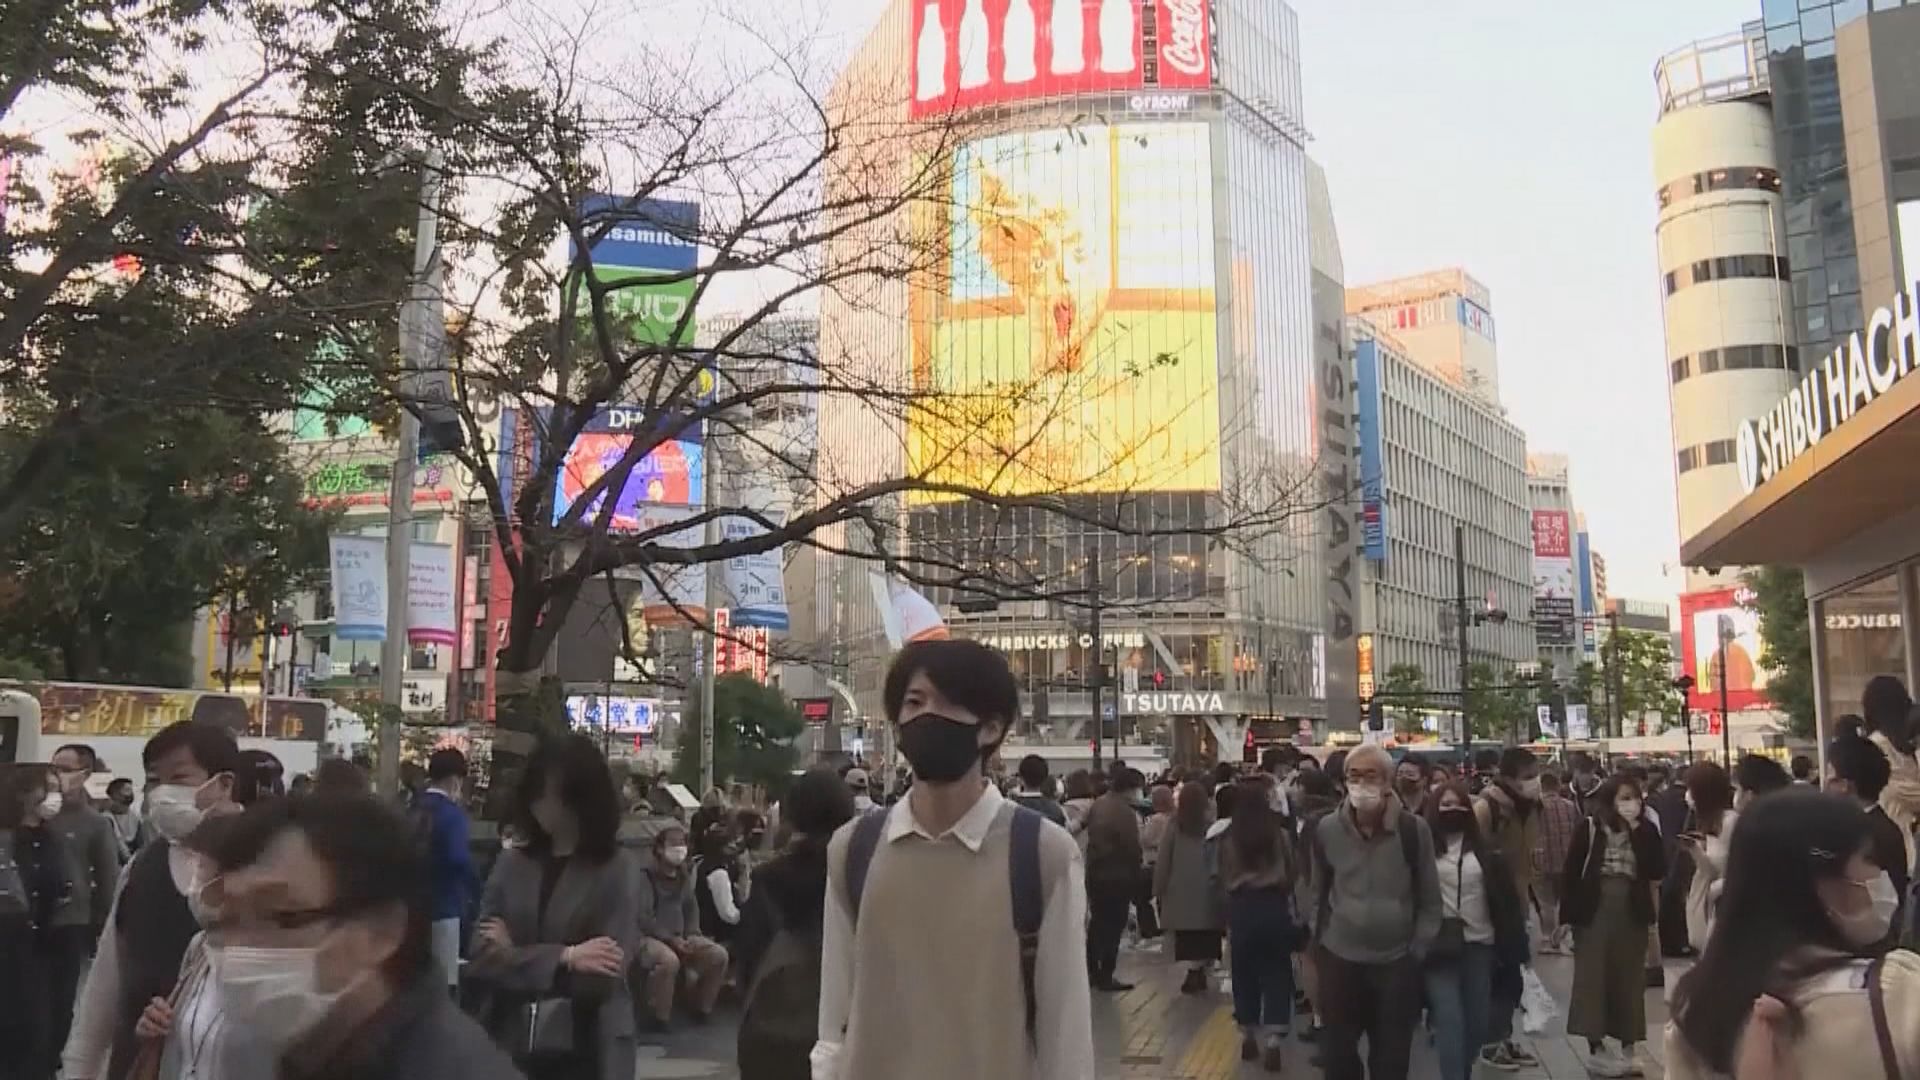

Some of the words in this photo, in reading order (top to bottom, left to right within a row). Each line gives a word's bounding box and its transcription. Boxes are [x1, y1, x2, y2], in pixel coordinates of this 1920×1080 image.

[1321, 319, 1354, 641] TSUTAYA
[1757, 368, 1822, 482] SHIBU
[1124, 694, 1223, 712] TSUTAYA
